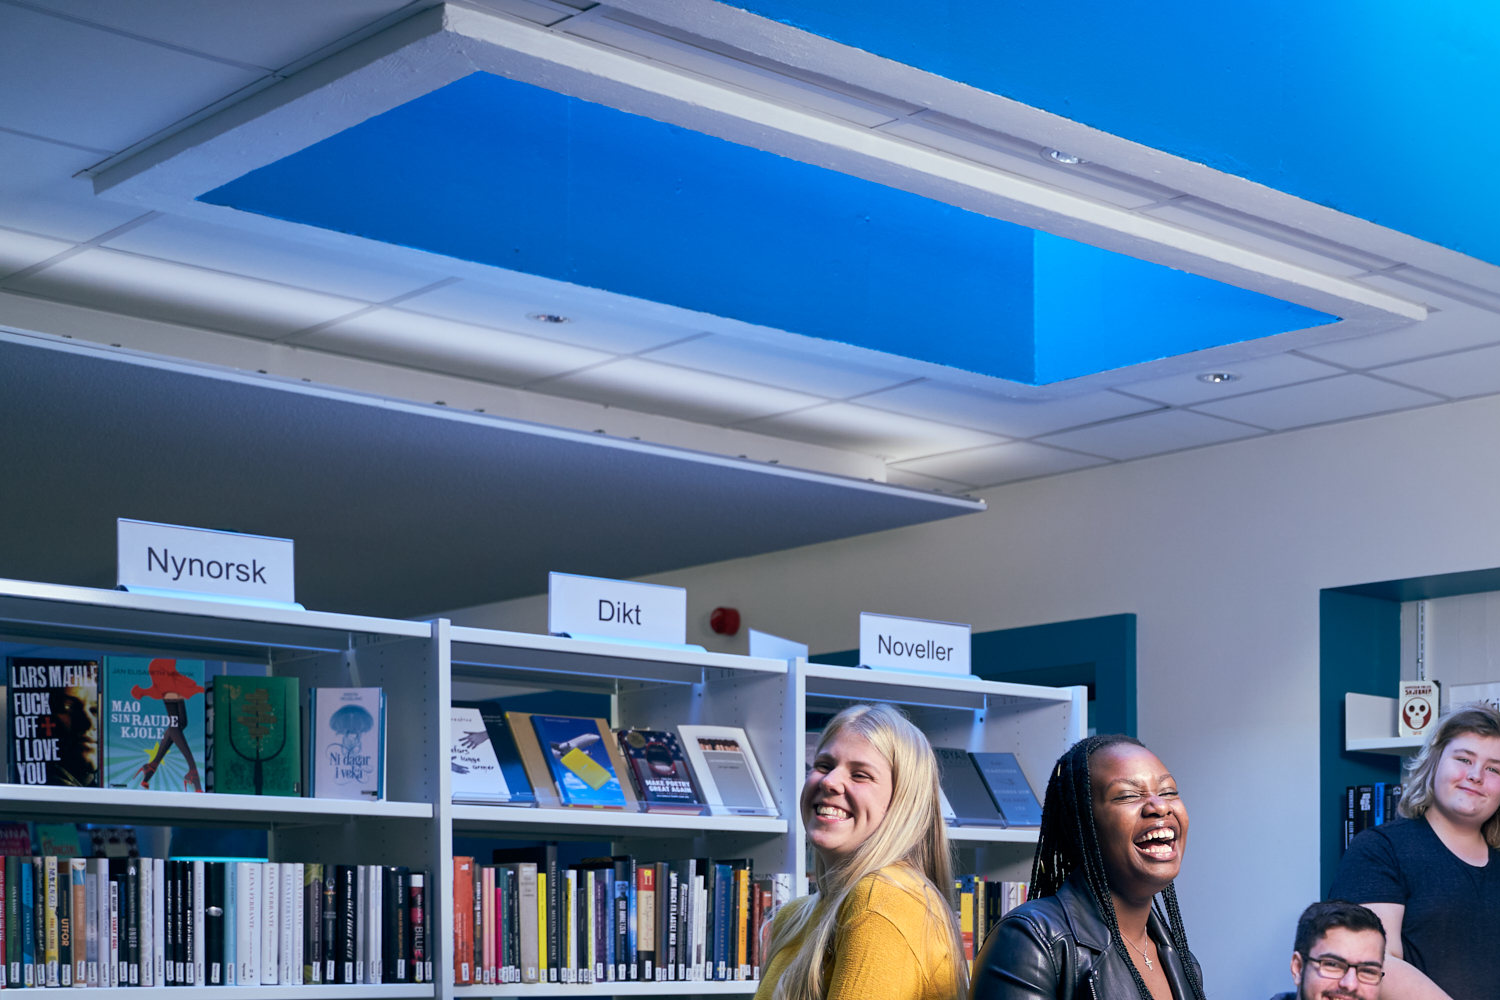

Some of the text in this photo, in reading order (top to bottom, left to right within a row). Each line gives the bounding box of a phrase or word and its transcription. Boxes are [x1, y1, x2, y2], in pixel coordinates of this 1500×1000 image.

[147, 546, 267, 585] Nynorsk
[599, 598, 642, 626] Dikt
[878, 634, 954, 662] Noveller
[12, 665, 98, 689] LARS MÆHLE
[14, 692, 52, 715] FUCK
[111, 700, 141, 713] MAO
[15, 716, 38, 739] OFF
[111, 714, 179, 728] SIN RAUDE
[120, 726, 165, 740] KJOLE
[16, 738, 61, 762] I LOVE
[342, 752, 372, 766] dagar
[17, 762, 47, 785] YOU
[61, 918, 69, 947] UTFOR
